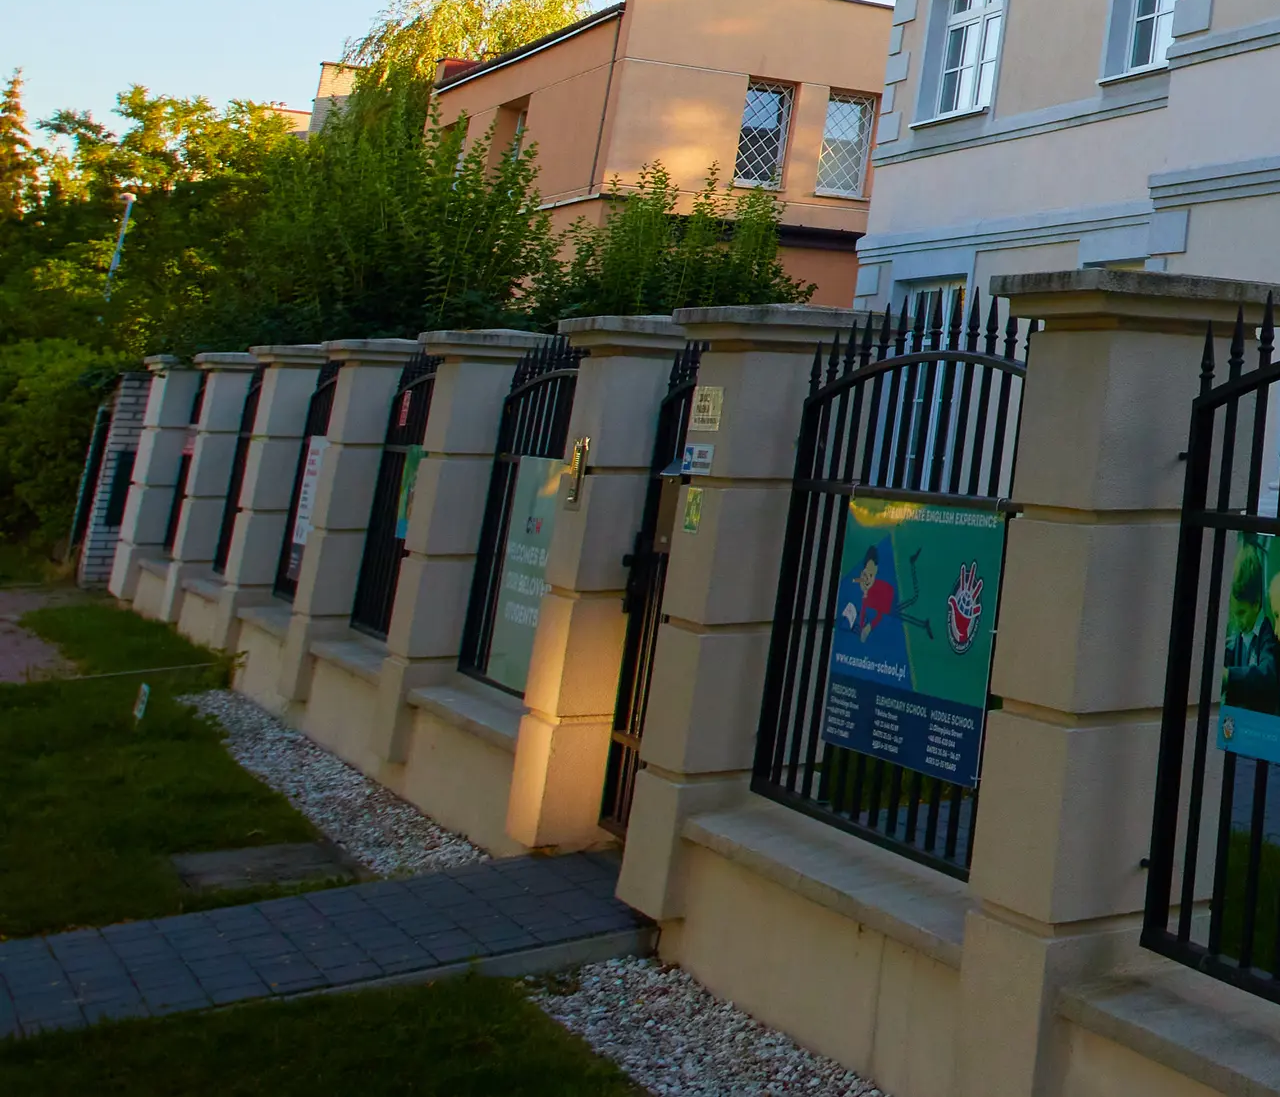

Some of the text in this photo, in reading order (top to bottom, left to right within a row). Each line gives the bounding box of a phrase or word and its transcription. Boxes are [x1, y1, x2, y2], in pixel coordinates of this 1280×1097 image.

[927, 509, 954, 524] ENGLISH
[955, 511, 997, 529] EXPERIENCE
[835, 653, 906, 682] www.canadian-school.pl
[906, 702, 927, 718] SCHOOL
[930, 709, 975, 730] MIDDLE SCHOOL
